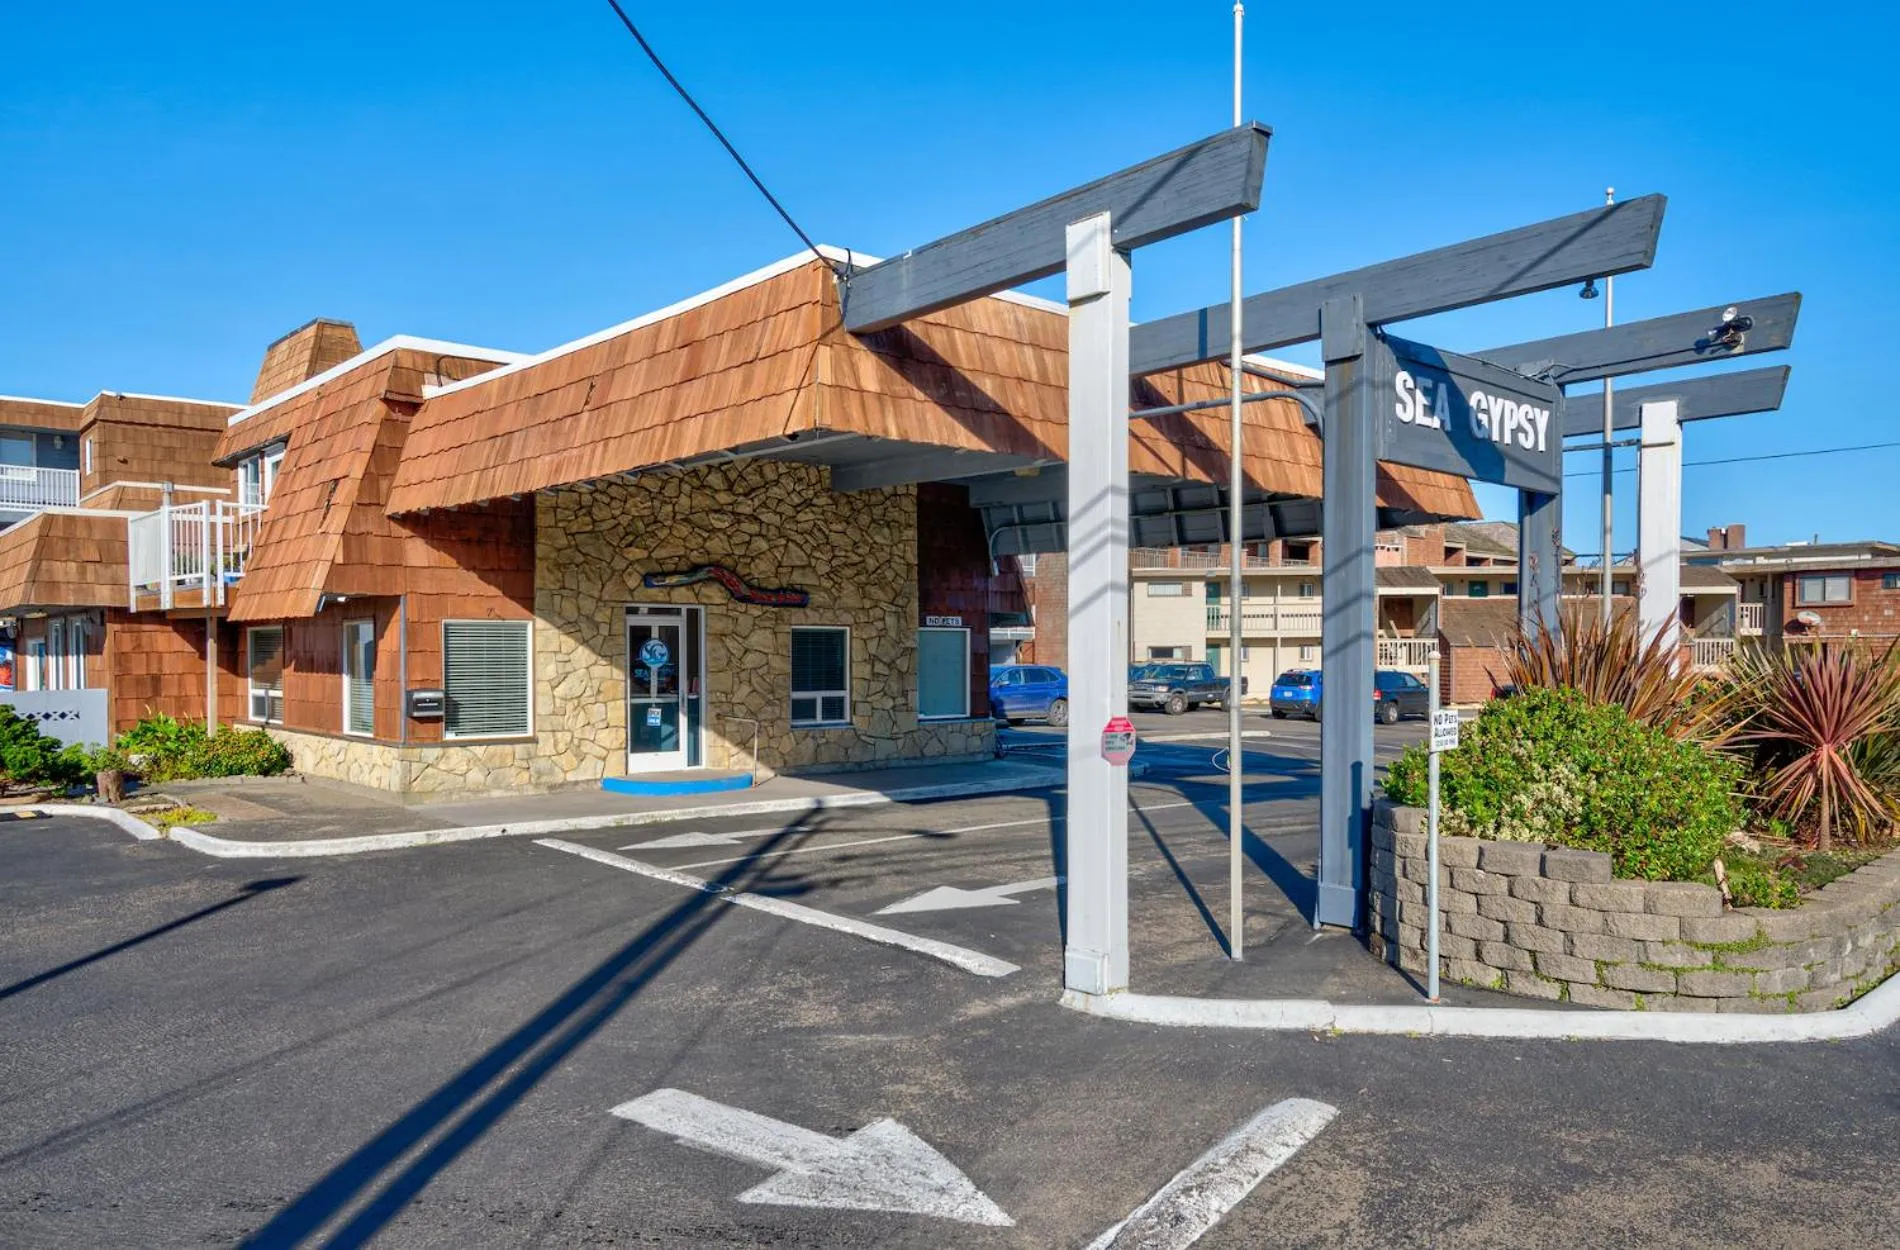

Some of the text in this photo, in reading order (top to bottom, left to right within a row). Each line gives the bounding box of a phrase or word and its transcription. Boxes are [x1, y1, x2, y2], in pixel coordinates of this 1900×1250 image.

[1395, 371, 1550, 452] SEA GYPSY
[1433, 714, 1443, 725] NO
